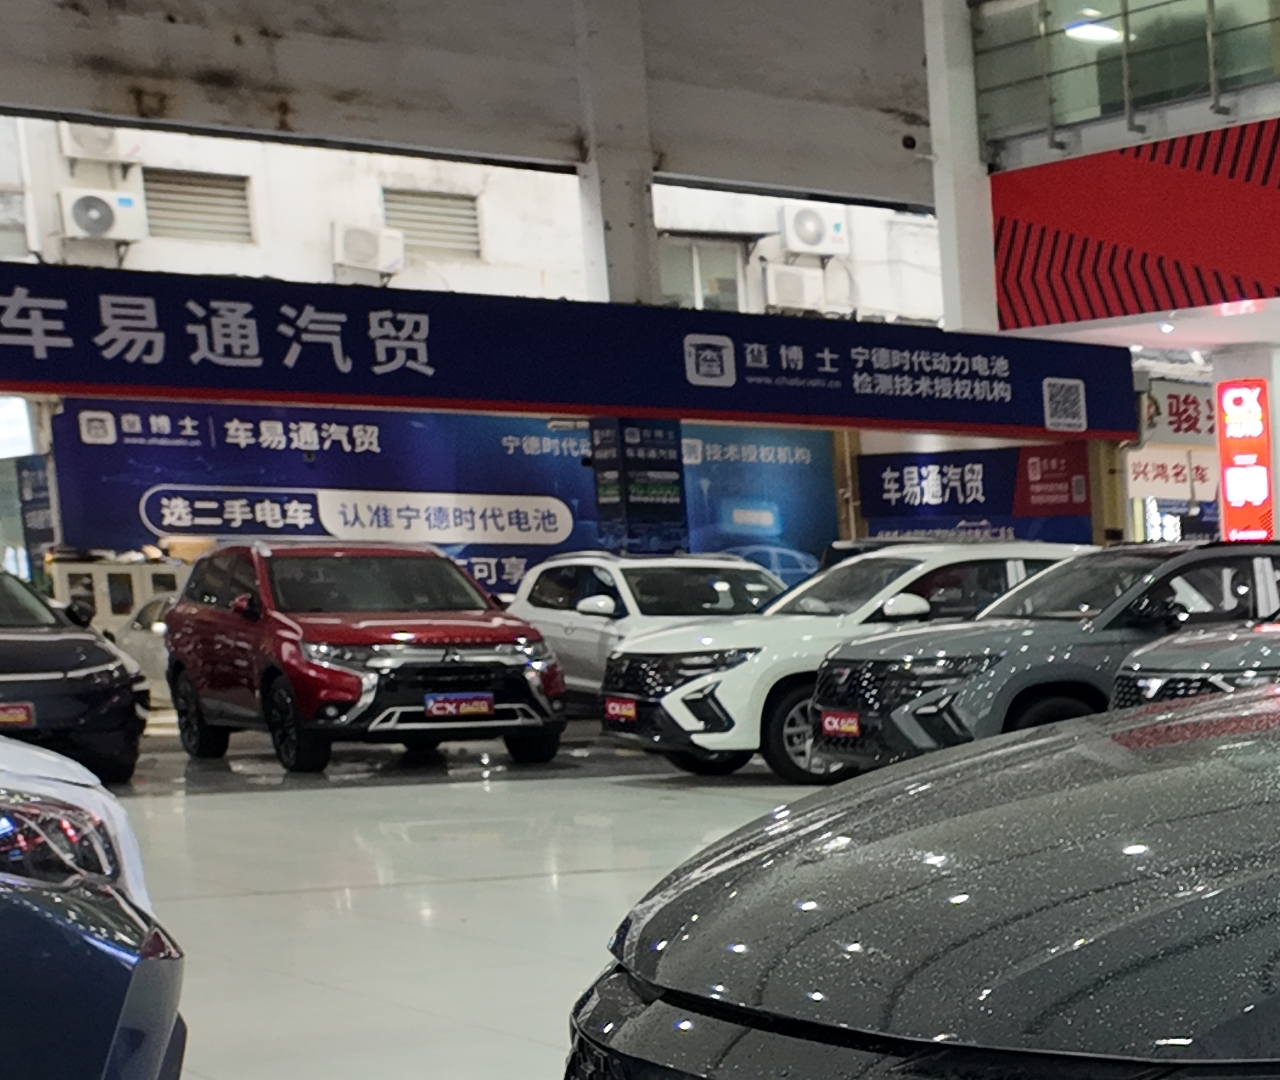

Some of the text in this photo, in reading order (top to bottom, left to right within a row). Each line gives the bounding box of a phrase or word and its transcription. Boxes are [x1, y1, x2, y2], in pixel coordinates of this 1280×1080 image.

[0, 287, 436, 377] 车易通汽贸
[744, 343, 1010, 378] 查博士 宁德时代动力电池
[853, 373, 1012, 403] 检测技术授权机构
[1166, 393, 1217, 434] 骏
[224, 418, 381, 453] 车易通汽贸
[882, 463, 986, 506] 车易通汽贸
[1131, 460, 1211, 485] 兴鸿名车
[161, 497, 560, 536] 选二手电车 认准宁德时代电池
[456, 555, 529, 587] 可享
